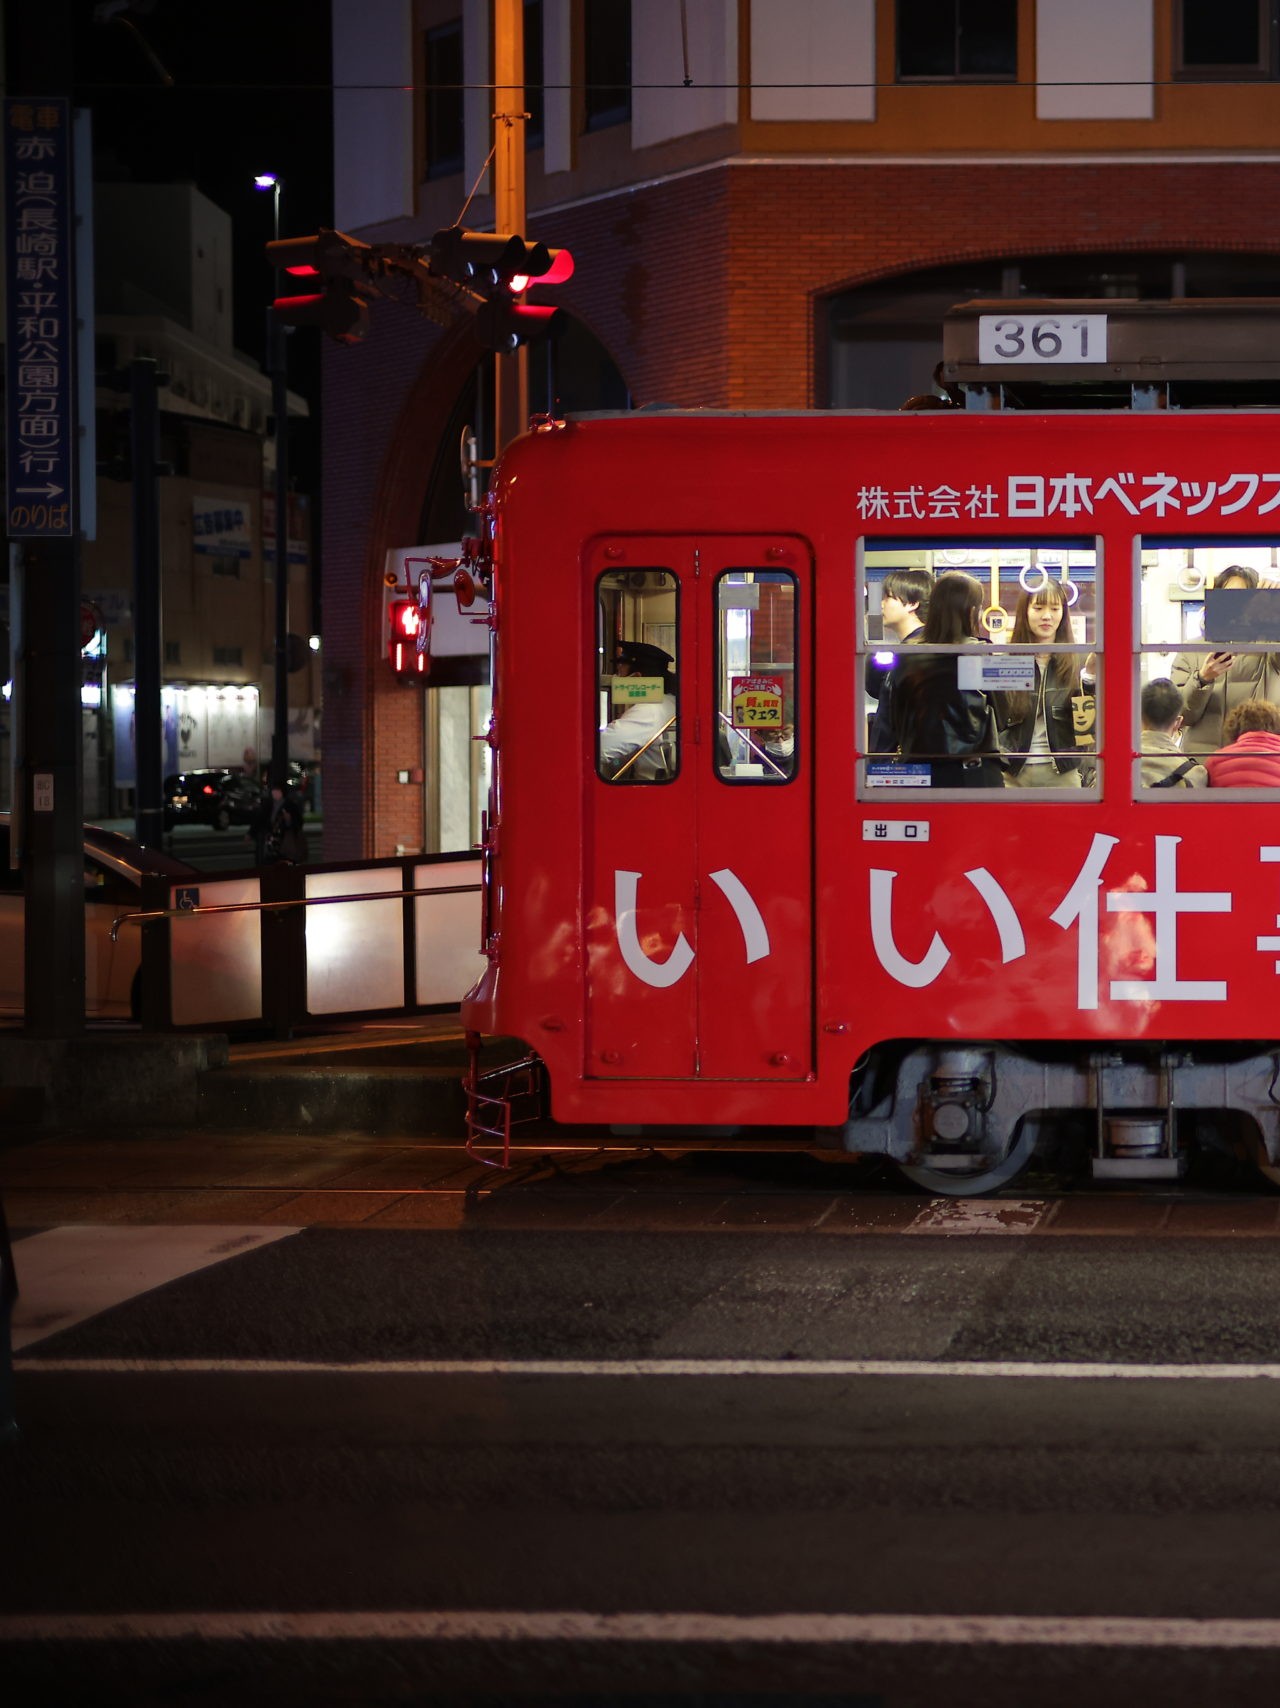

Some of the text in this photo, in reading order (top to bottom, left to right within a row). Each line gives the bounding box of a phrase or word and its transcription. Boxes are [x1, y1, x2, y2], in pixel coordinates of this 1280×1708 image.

[10, 104, 60, 131] 電車
[994, 319, 1090, 358] 361
[10, 504, 68, 530] のりば
[875, 823, 917, 837] 出口
